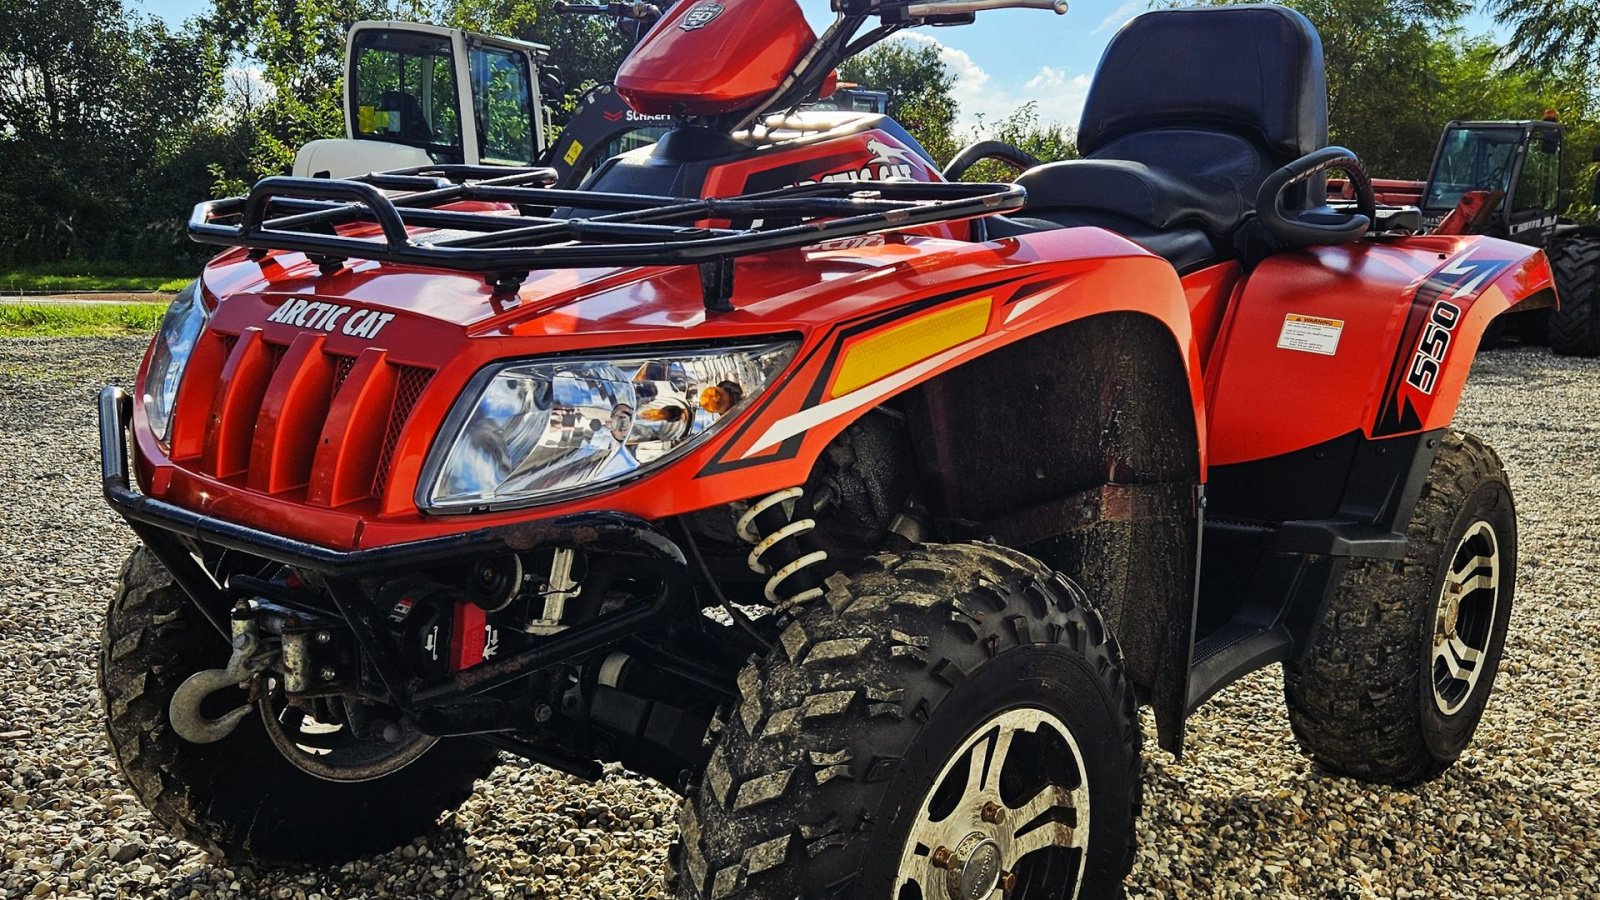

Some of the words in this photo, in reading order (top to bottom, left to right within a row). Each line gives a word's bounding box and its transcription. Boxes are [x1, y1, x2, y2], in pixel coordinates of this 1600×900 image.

[688, 11, 713, 21] 50
[267, 298, 351, 333] ARCTIC
[342, 308, 396, 340] CAT
[1303, 317, 1334, 327] WARNING
[1406, 299, 1461, 395] 550
